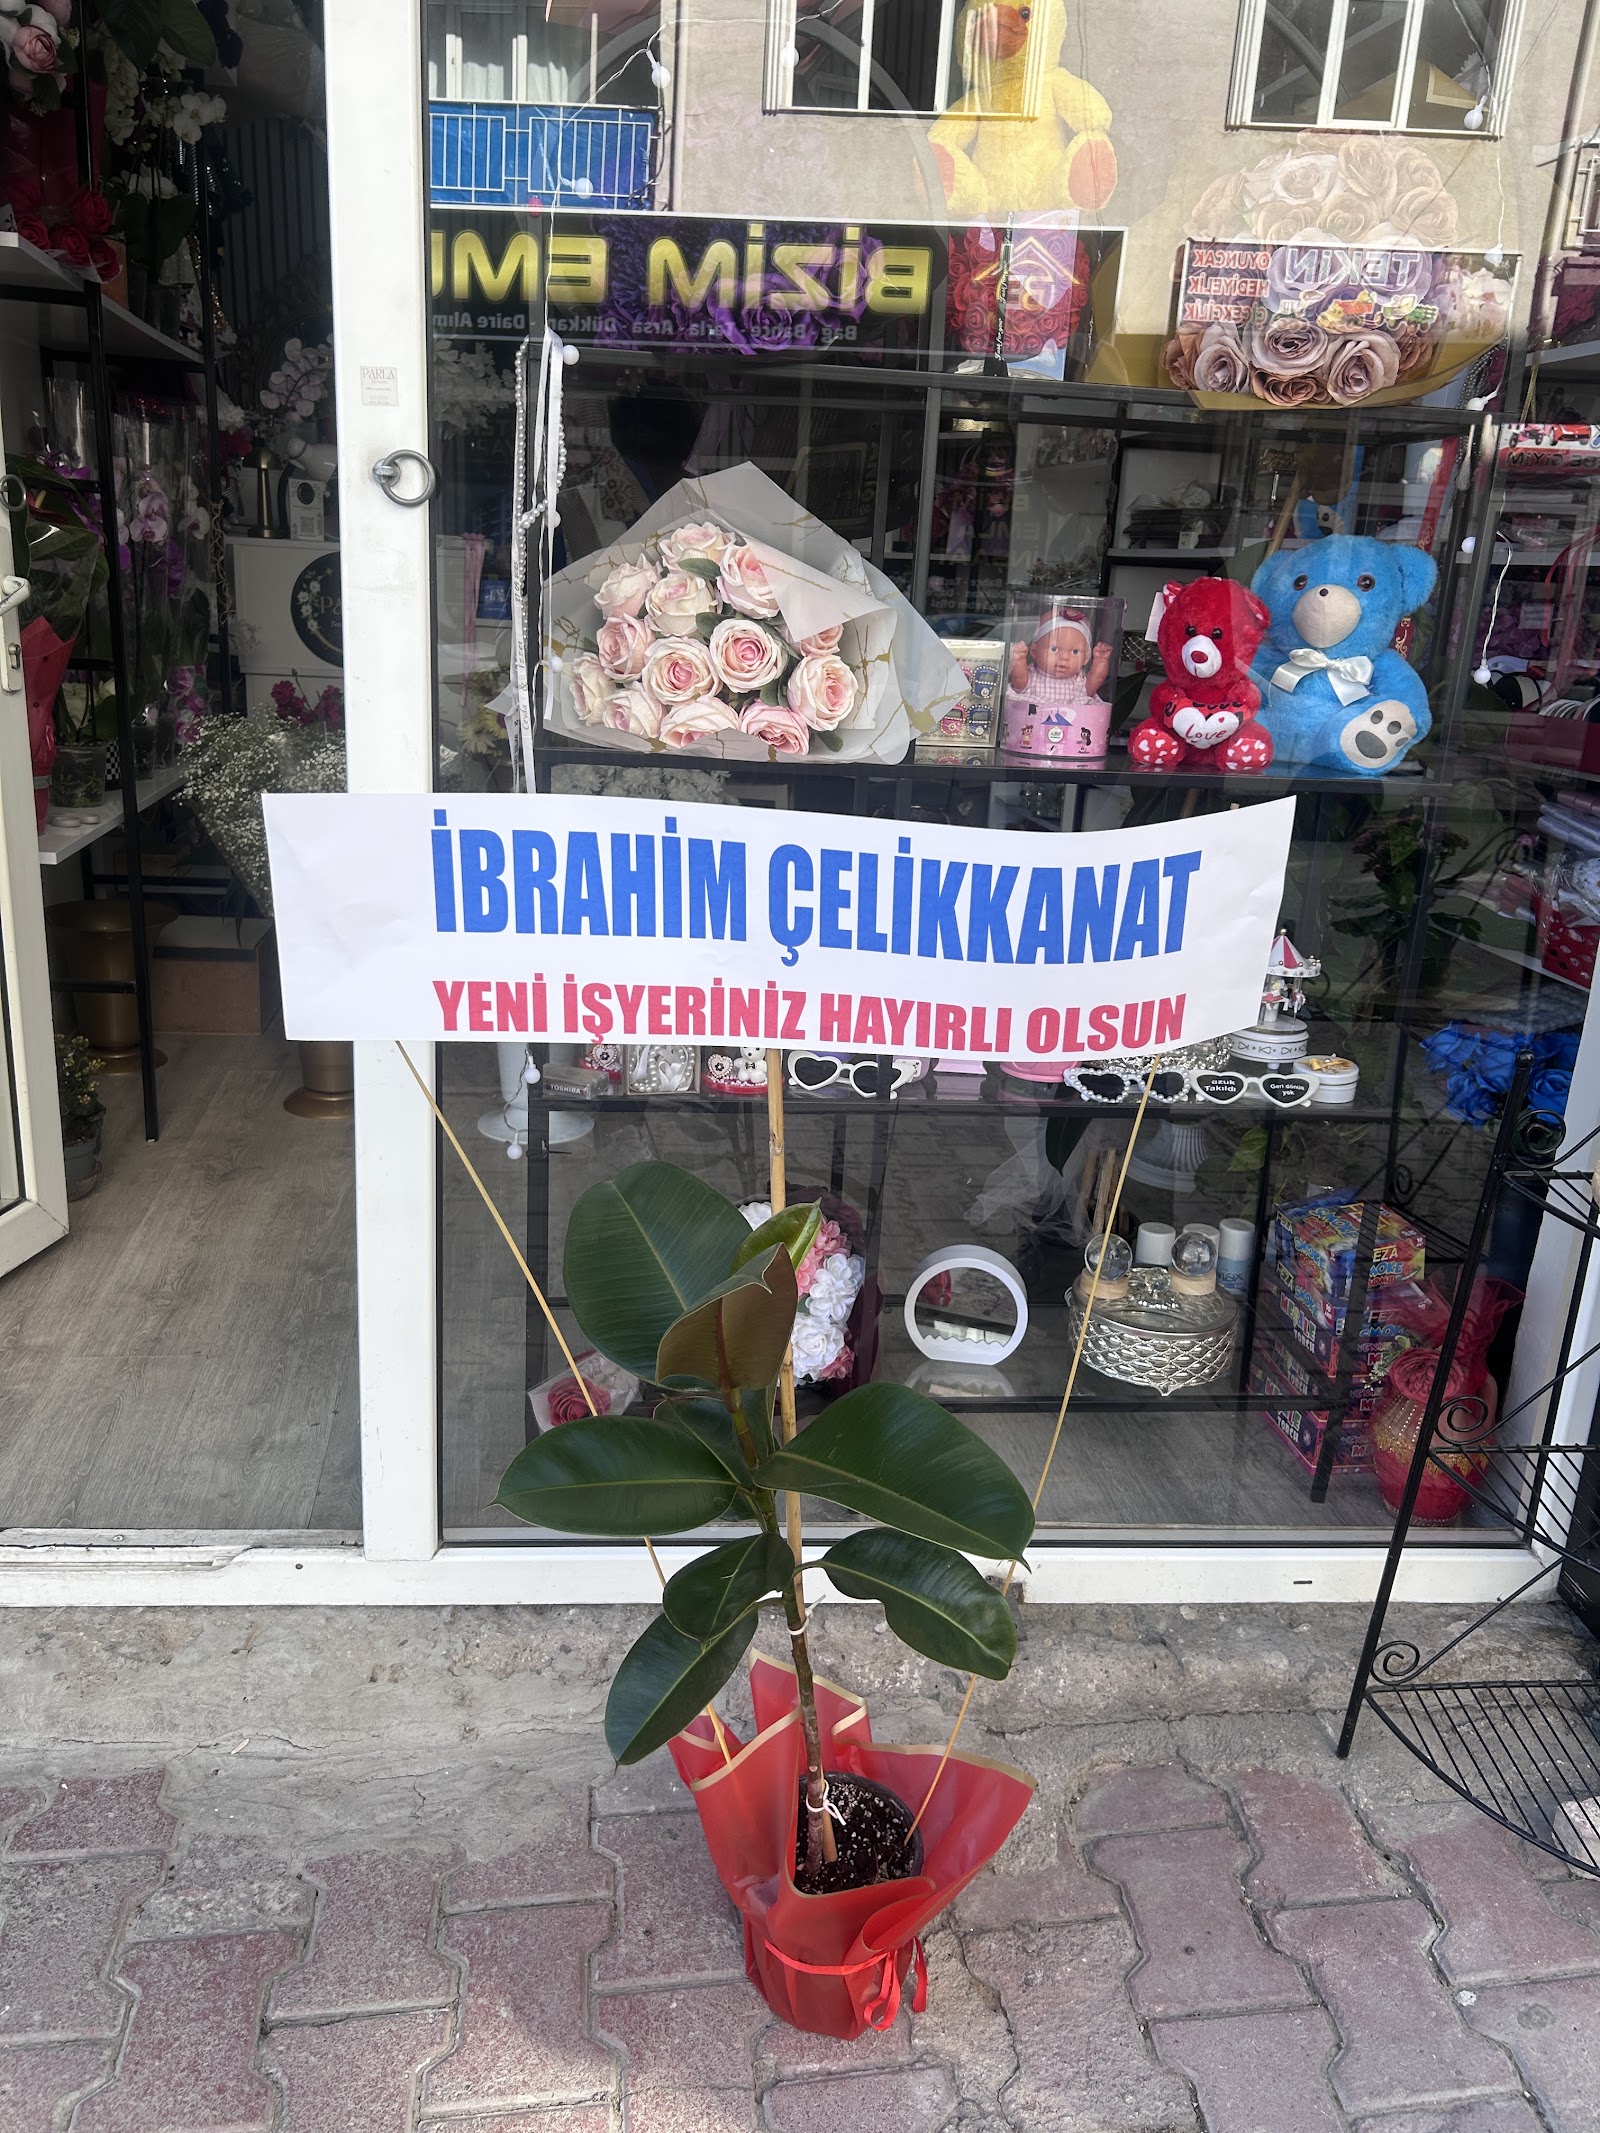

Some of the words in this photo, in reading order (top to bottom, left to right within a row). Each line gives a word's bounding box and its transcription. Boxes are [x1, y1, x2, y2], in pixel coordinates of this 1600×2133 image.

[362, 367, 396, 380] PARLA
[432, 809, 747, 942] İBRAHİM
[768, 837, 1202, 967] ÇELİKKANAT
[433, 973, 548, 1033] YENİ
[563, 973, 807, 1045] İŞYERİNİZ
[820, 993, 1012, 1053] HAYIRLI
[1026, 994, 1187, 1054] OLSUN
[549, 1084, 581, 1094] TOSHIBA
[1372, 1245, 1399, 1263] EZA
[1369, 1261, 1404, 1277] MOKE
[1359, 1323, 1408, 1337] SMOK
[1276, 1415, 1300, 1443] TORCH
